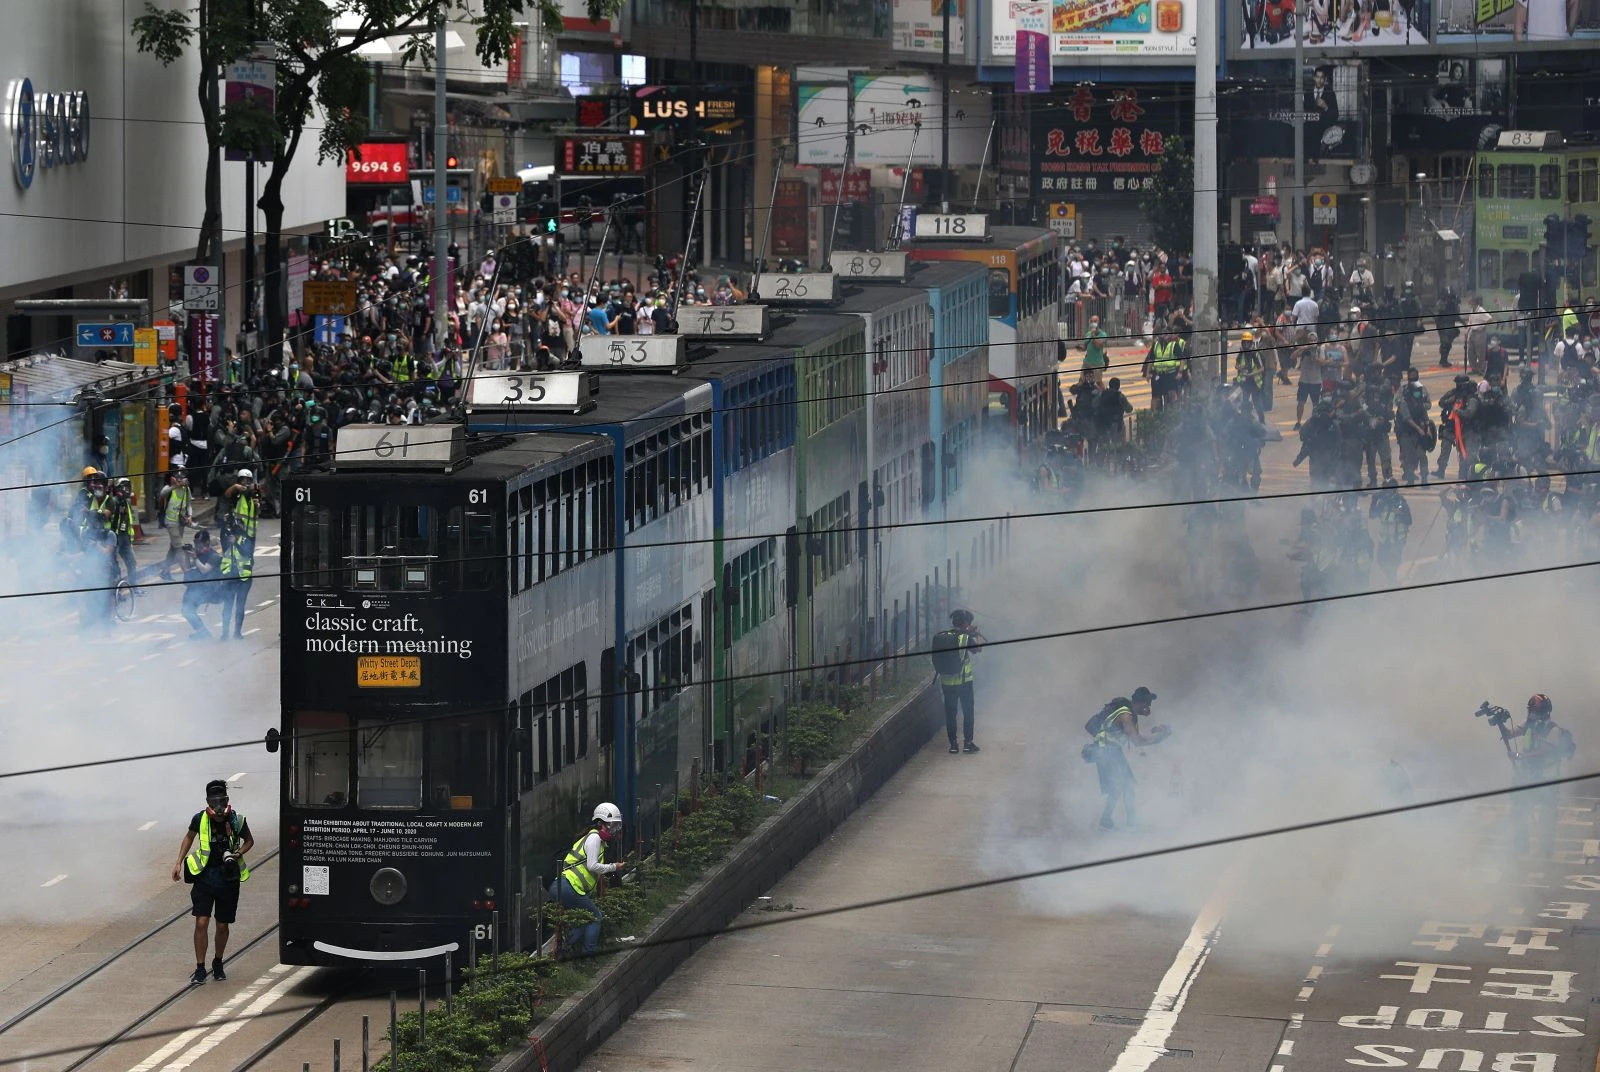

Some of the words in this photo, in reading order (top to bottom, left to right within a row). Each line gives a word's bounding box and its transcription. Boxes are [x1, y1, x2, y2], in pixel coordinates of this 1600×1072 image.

[707, 100, 736, 109] FRESH
[1511, 132, 1533, 146] 83
[352, 161, 389, 173] 9694
[393, 161, 402, 173] 6
[934, 217, 967, 235] 118
[850, 255, 882, 276] 89
[991, 255, 1007, 264] 118
[206, 287, 212, 295] 7
[776, 277, 808, 298] 26
[205, 299, 216, 309] 12
[697, 311, 736, 333] 75
[609, 339, 648, 364] 53
[506, 376, 547, 402] 35
[374, 431, 409, 458] 61
[295, 487, 312, 502] 61
[468, 488, 488, 504] 61
[305, 612, 367, 632] classic
[372, 613, 424, 635] craft,
[306, 634, 380, 653] modern
[386, 635, 473, 659] meaning
[360, 658, 378, 670] Whitty
[380, 658, 399, 668] Street
[400, 658, 419, 669] Depot
[474, 924, 494, 940] 61
[1378, 961, 1582, 1003] 巴士
[1337, 1005, 1585, 1038] STOP
[1345, 1044, 1560, 1072] BUS
